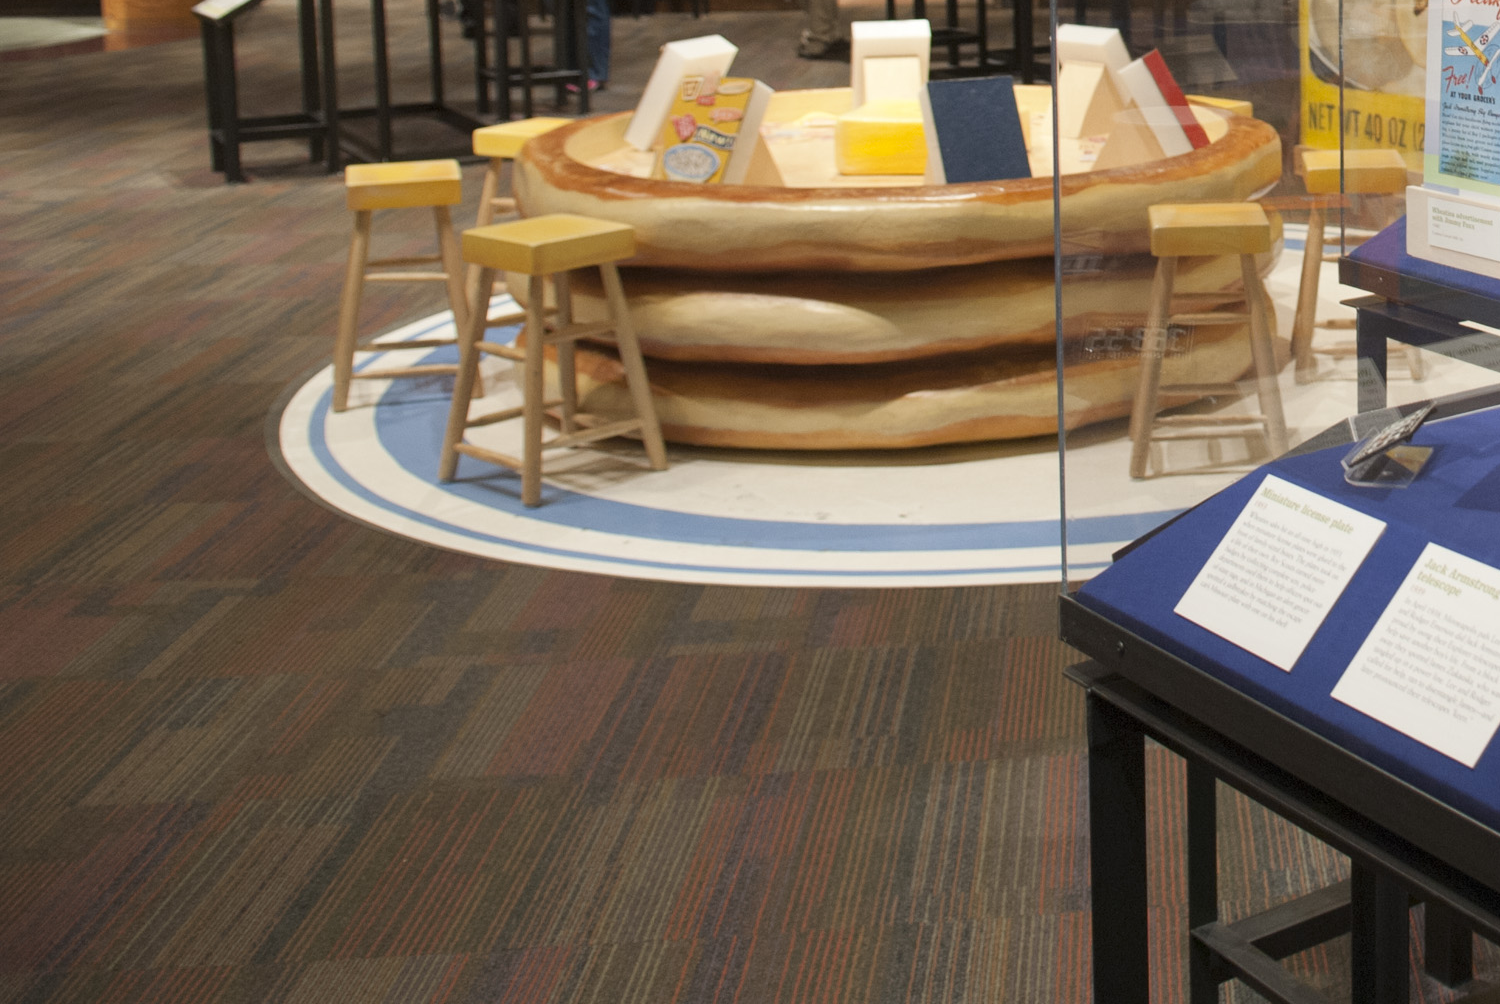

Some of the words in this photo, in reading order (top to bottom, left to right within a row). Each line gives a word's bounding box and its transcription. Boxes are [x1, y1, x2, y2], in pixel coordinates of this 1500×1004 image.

[1442, 65, 1474, 93] Free!
[1458, 92, 1471, 100] YOUR
[1308, 102, 1335, 131] NET
[1365, 113, 1383, 143] 40
[1388, 116, 1407, 147] OZ
[1259, 486, 1303, 512] Miniature
[1299, 503, 1334, 525] license
[1327, 517, 1356, 537] plate
[1422, 557, 1450, 576] Jack
[1414, 570, 1464, 598] telescope
